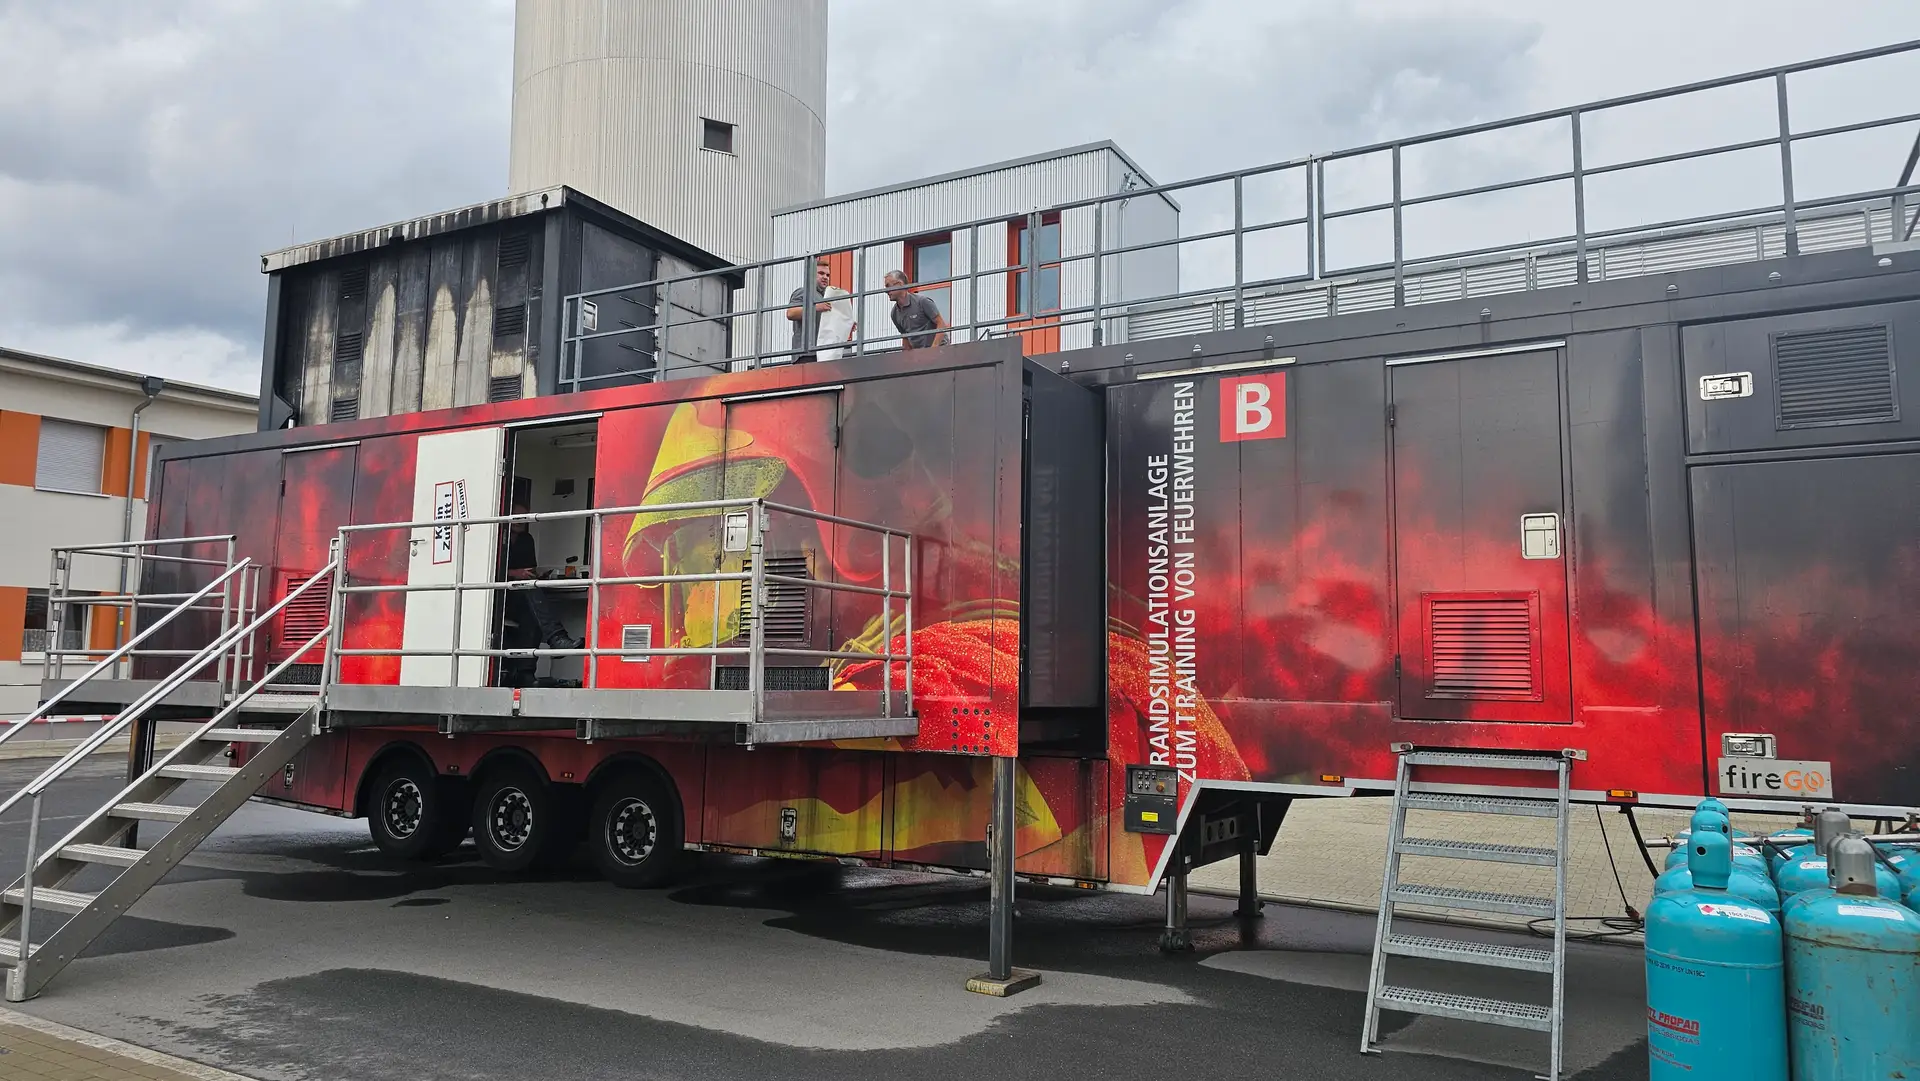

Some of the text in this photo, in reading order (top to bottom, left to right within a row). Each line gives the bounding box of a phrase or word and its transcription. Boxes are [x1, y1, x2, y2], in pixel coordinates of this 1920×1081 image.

[1236, 382, 1272, 434] B
[435, 506, 444, 540] Kin
[442, 502, 452, 551] Zutitt
[457, 482, 468, 530] itstand
[1174, 381, 1197, 783] ZUM TRAINING VON FEUERWEHREN
[1148, 454, 1170, 766] RANDSIMULATIONSANLAGE
[1726, 764, 1825, 792] fireGO
[1659, 1011, 1700, 1031] PROPAN
